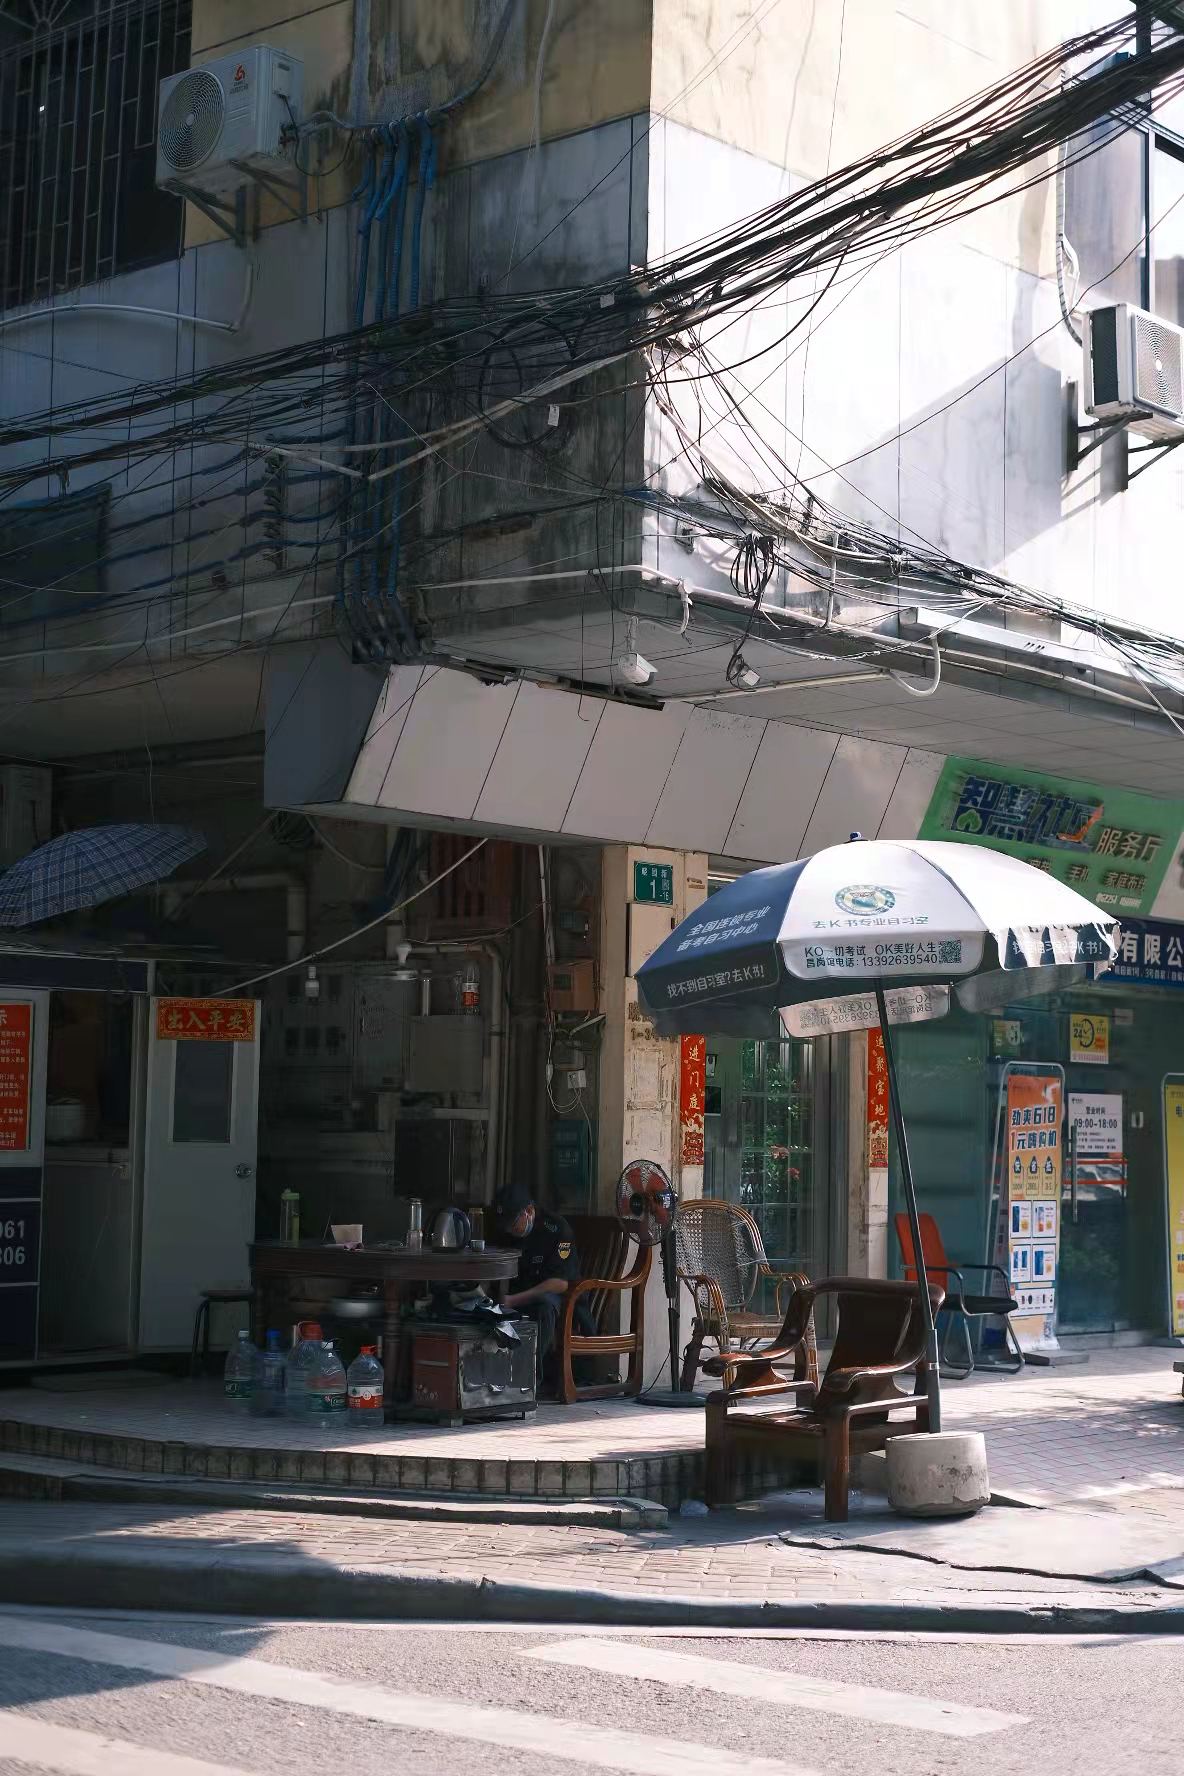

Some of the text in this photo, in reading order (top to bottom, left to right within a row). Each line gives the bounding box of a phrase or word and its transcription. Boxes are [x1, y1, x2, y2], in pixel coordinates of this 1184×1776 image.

[1096, 827, 1162, 863] 服务厅
[874, 942, 937, 956] OK美好人生
[167, 1009, 244, 1032] 出入平安
[1073, 1027, 1083, 1039] 24
[1011, 1105, 1057, 1127] 劲爽618
